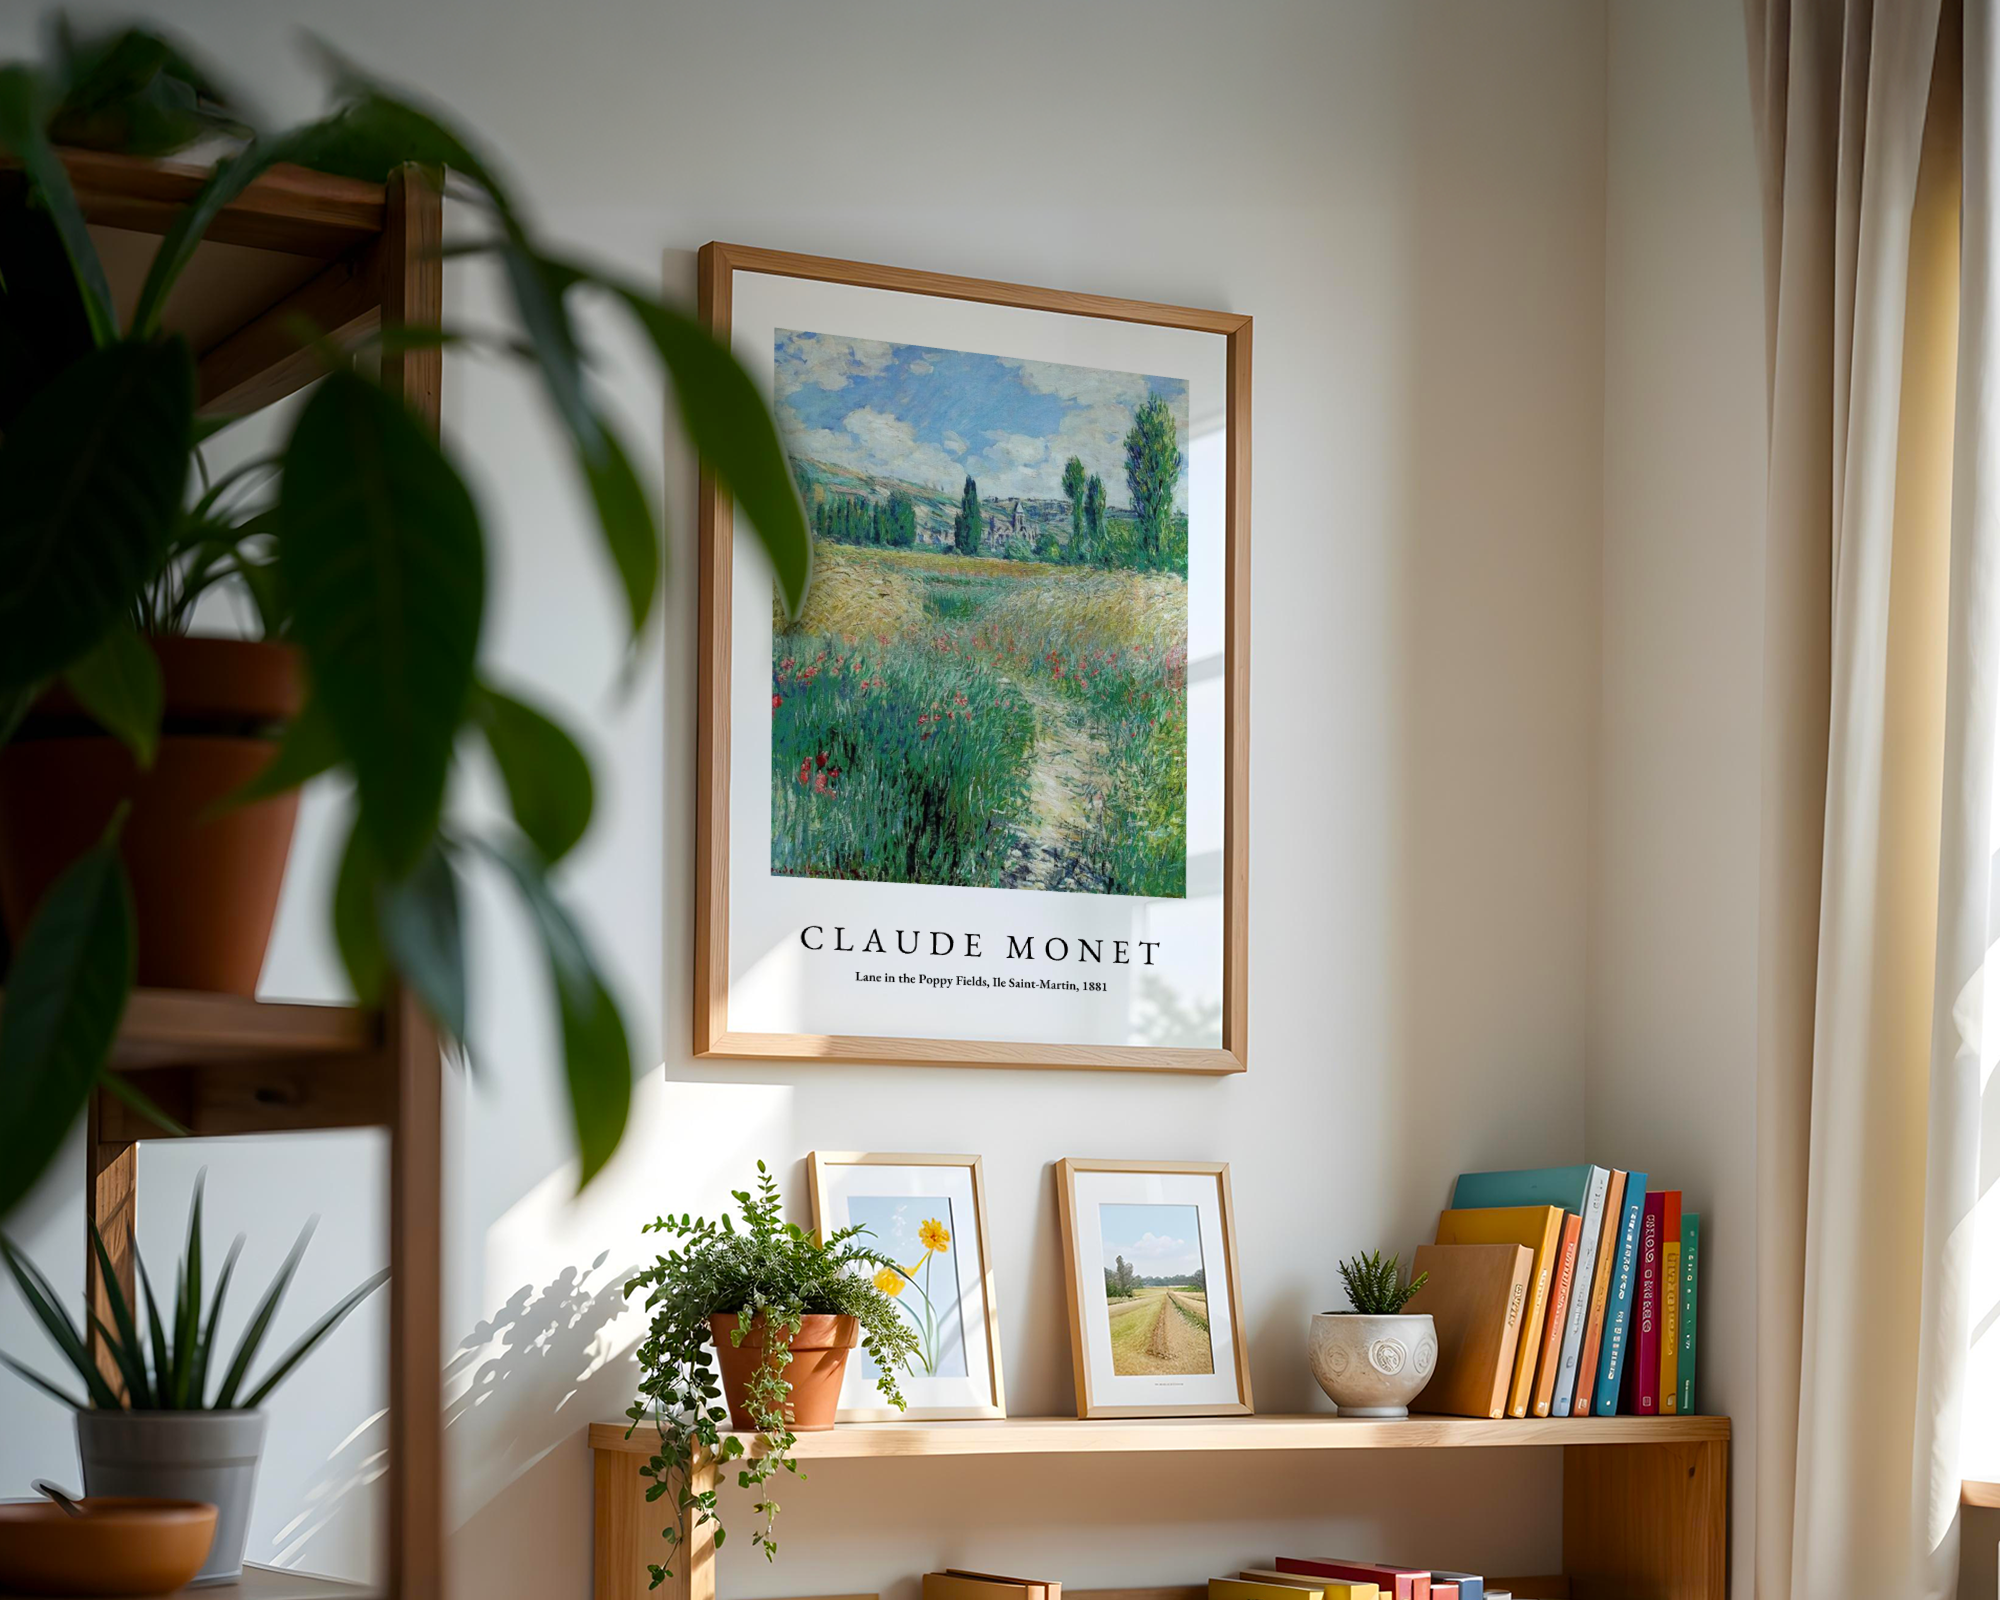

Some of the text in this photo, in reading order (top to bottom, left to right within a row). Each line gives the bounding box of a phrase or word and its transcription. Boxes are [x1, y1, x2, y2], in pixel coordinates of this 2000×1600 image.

[800, 925, 1161, 966] CLAUDE MONET
[855, 971, 1108, 993] Lane in the Poppy Fields, Ile Saint-Martin, 1881
